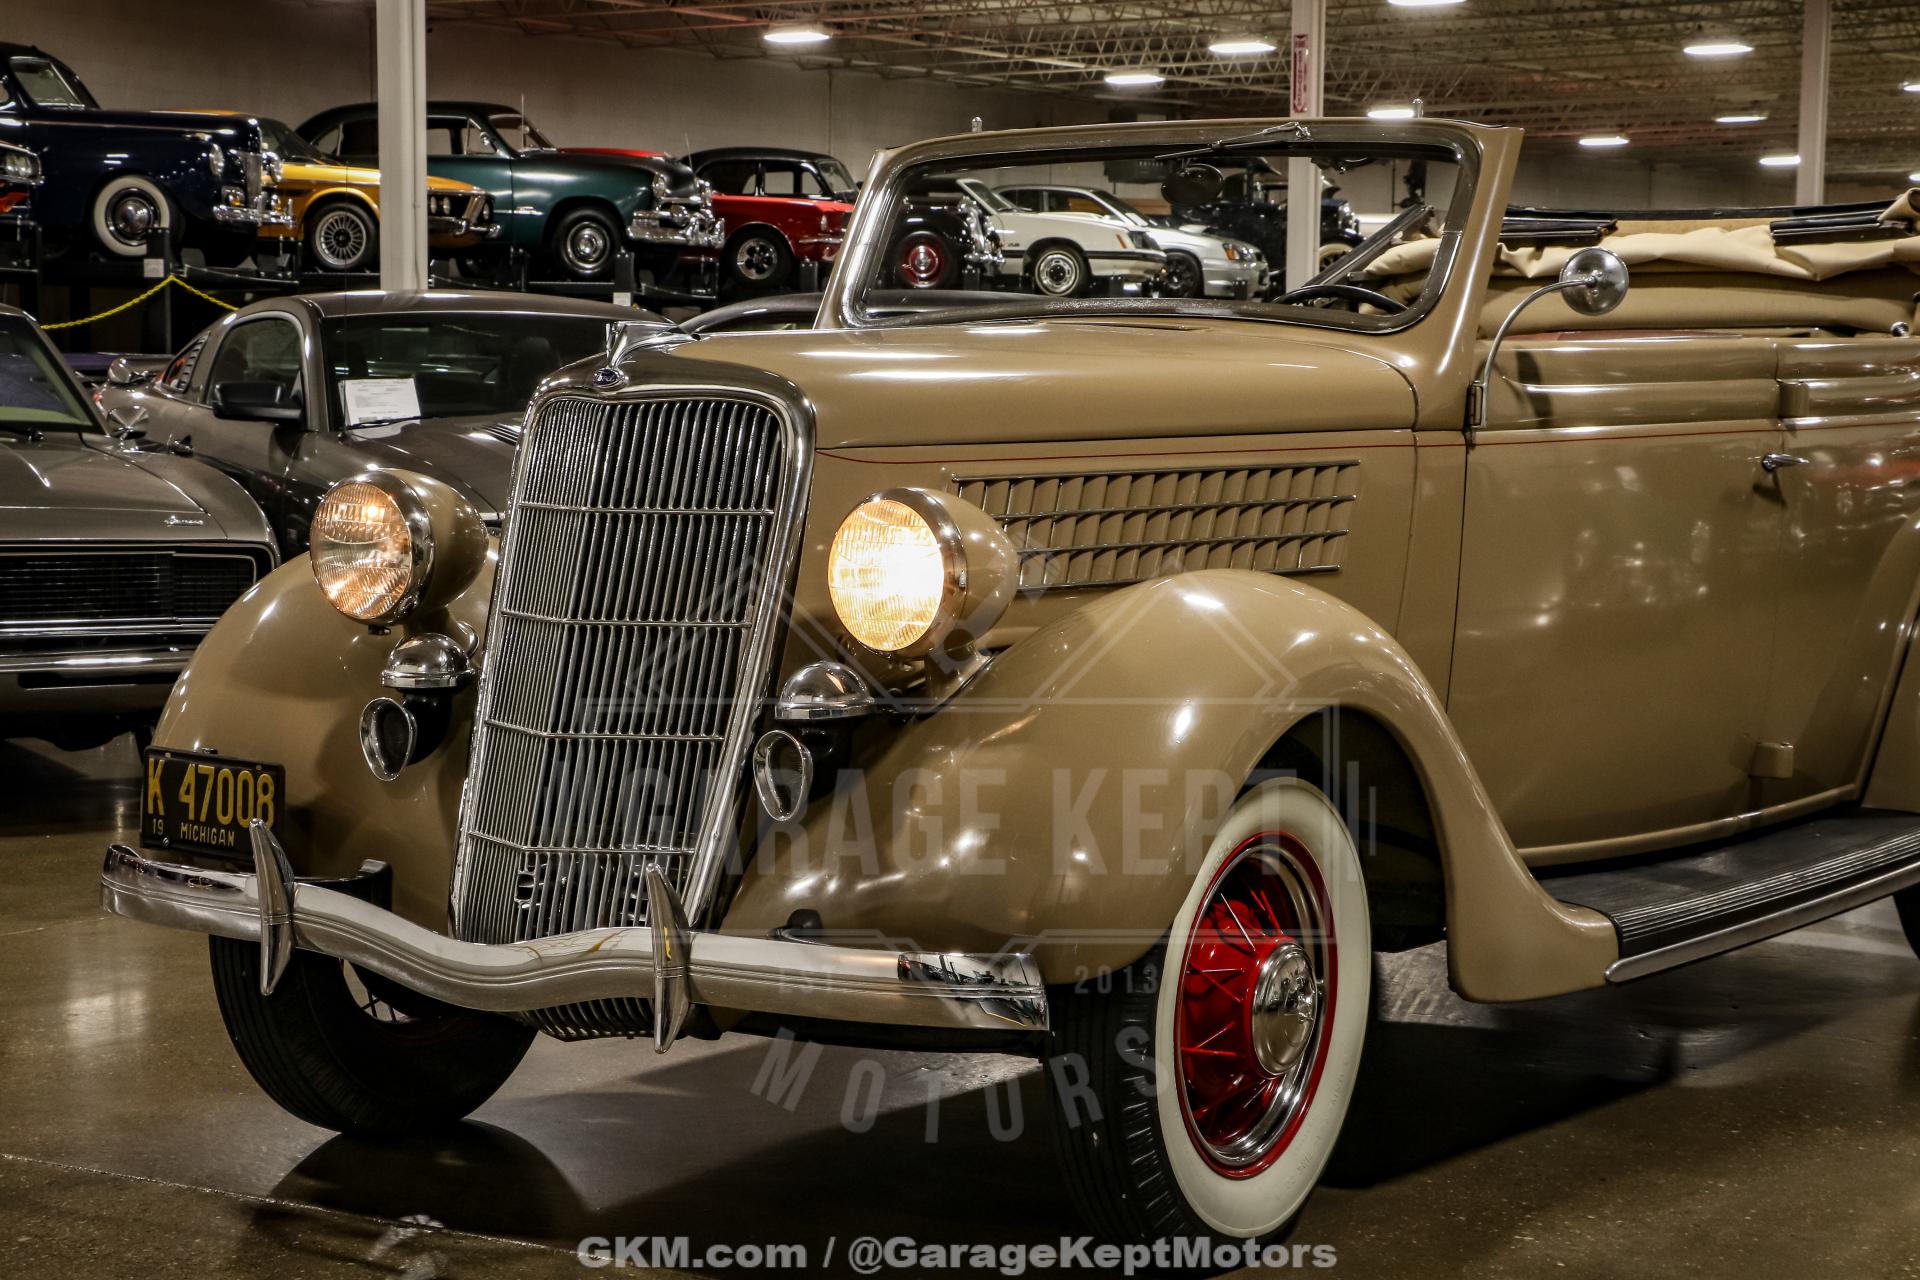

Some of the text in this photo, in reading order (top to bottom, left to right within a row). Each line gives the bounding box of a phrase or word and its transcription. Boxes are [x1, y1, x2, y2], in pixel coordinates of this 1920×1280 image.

[147, 758, 275, 830] K 47008
[152, 818, 235, 847] 19 MICHIGAN
